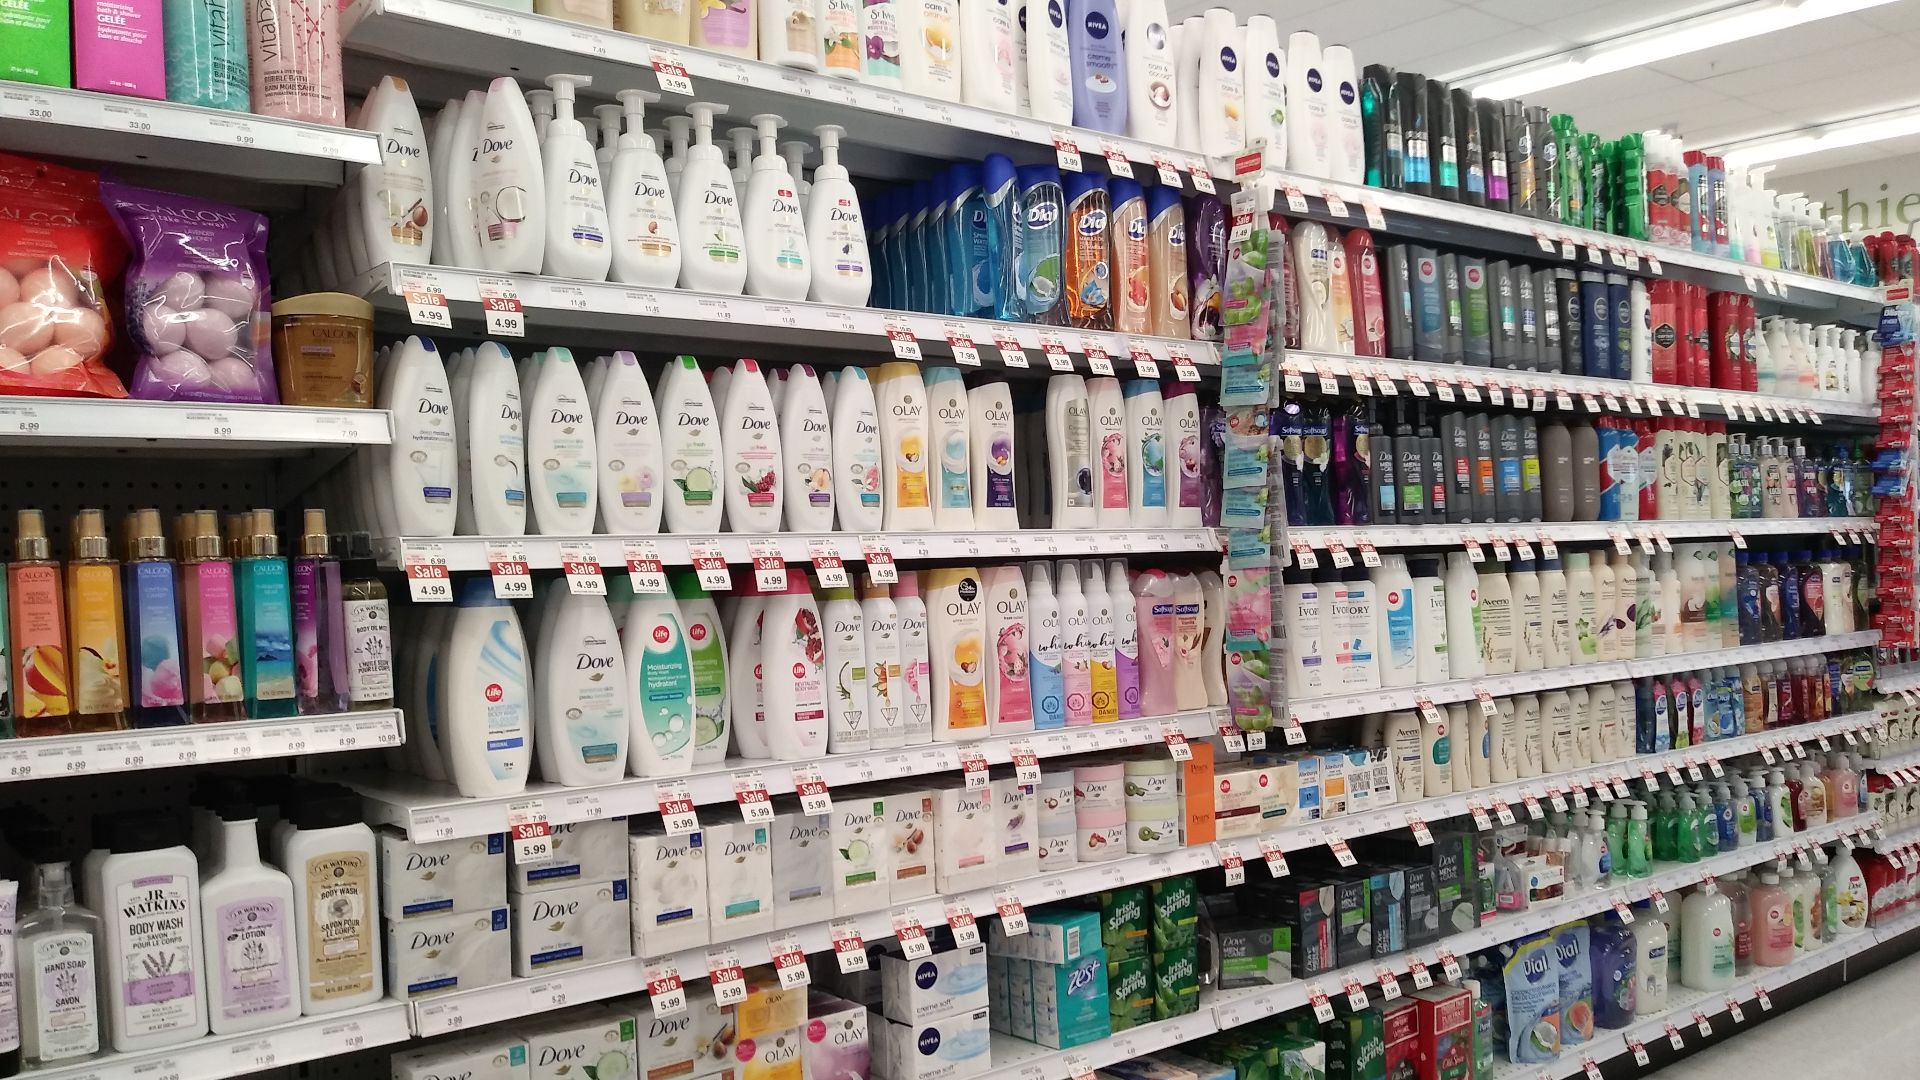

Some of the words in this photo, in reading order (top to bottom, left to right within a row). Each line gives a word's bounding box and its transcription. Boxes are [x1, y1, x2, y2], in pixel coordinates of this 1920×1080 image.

[97, 14, 126, 25] GELÉE
[1086, 23, 1107, 33] NIVEA
[592, 46, 606, 55] 7.49
[1087, 55, 1110, 64] creme
[1221, 55, 1236, 64] NIVEA
[658, 63, 683, 77] Sale
[666, 78, 688, 90] 3.99
[1308, 76, 1322, 85] NIVEA
[264, 84, 280, 93] BAIN
[29, 110, 52, 118] 33.00
[236, 135, 254, 144] 9.99
[386, 138, 421, 158] Dove
[482, 138, 513, 154] Dove
[1063, 157, 1078, 167] 3.99
[1115, 164, 1130, 175] 3.99
[569, 168, 597, 188] Dove
[773, 198, 799, 216] Dove
[137, 202, 238, 224] CALGON
[831, 207, 858, 223] Dove
[1028, 206, 1056, 225] Dial
[1234, 229, 1248, 239] 1.49
[426, 286, 442, 294] 6.99
[502, 291, 517, 300] 6.99
[489, 298, 516, 311] Sale
[418, 310, 443, 321] 4.99
[495, 318, 518, 330] 4.99
[312, 329, 356, 338] CALGON
[892, 331, 912, 342] Sale
[898, 345, 916, 355] 7.99
[959, 352, 975, 361] 7.99
[1008, 355, 1024, 363] 3.99
[1054, 359, 1070, 367] 3.99
[1288, 380, 1301, 388] 3.99
[419, 398, 449, 416] Dove
[502, 404, 521, 421] Dove
[893, 404, 921, 417] OLAY
[551, 409, 583, 424] Dove
[938, 408, 965, 420] OLAY
[985, 410, 1011, 421] OLAY
[19, 422, 40, 431] 8.99
[1100, 416, 1123, 426] OLAY
[214, 427, 232, 436] 8.99
[1303, 557, 1315, 565] 2.99
[1337, 556, 1350, 565] 2.99
[1367, 556, 1378, 564] 2.99
[18, 572, 53, 581] CALGON
[138, 566, 171, 576] CALGON
[414, 565, 441, 579] Sale
[877, 569, 894, 579] 4.99
[825, 573, 843, 583] 4.99
[420, 585, 446, 596] 4.99
[504, 582, 527, 592] 4.99
[1482, 598, 1509, 606] Aveeno
[946, 602, 980, 616] OLAY
[1176, 605, 1199, 616] Softsoap
[357, 626, 370, 634] BODY
[691, 628, 705, 637] Life
[576, 653, 614, 671] Dove
[647, 663, 682, 673] Moisturizing
[793, 666, 805, 675] Life
[648, 679, 677, 688] hydratant
[486, 688, 502, 698] Life
[377, 735, 397, 744] 10.99
[1228, 739, 1242, 748] 2.99
[233, 746, 251, 755] 8.99
[288, 741, 305, 750] 8.99
[1175, 748, 1189, 757] 2.99
[66, 761, 86, 771] 8.99
[125, 756, 144, 765] 8.99
[11, 766, 31, 776] 8.99
[1191, 763, 1209, 773] Pears
[1022, 771, 1037, 780] 7.99
[970, 777, 985, 786] 7.99
[665, 801, 689, 814] Sale
[808, 800, 826, 811] 5.99
[586, 807, 602, 816] 11.99
[750, 807, 770, 818] 5.99
[1192, 812, 1209, 823] Pears
[672, 818, 694, 829] 5.99
[436, 828, 454, 837] 11.99
[523, 843, 546, 856] 5.99
[1230, 872, 1242, 880] 3.99
[146, 889, 163, 903] JR
[321, 891, 338, 900] BODY
[340, 888, 358, 897] WASH
[1166, 888, 1185, 905] Irish
[123, 898, 187, 919] WATKINS
[1114, 900, 1135, 916] Irish
[1159, 893, 1191, 918] Spring
[1109, 906, 1141, 930] Spring
[129, 920, 154, 935] BODY
[157, 917, 183, 932] WASH
[241, 930, 266, 939] LOTION
[900, 927, 921, 939] Sale
[133, 941, 151, 949] POUR
[163, 936, 182, 945] CORPS
[839, 938, 859, 951] Sale
[1556, 944, 1579, 963] Dial
[45, 962, 65, 973] HAND
[66, 960, 87, 970] SOAP
[1168, 958, 1188, 974] Irish
[1524, 958, 1548, 975] Dial
[664, 968, 677, 977] 7.29
[917, 971, 937, 980] NIVEA
[1120, 970, 1142, 985] Irish
[1162, 962, 1193, 988] Spring
[56, 996, 80, 1007] SAVON
[660, 997, 680, 1009] 5.99
[916, 1005, 940, 1014] creme
[941, 999, 952, 1007] soft
[447, 1015, 463, 1026] 3.99
[345, 1036, 363, 1046] 10.99
[920, 1037, 938, 1046] NIVEA
[1360, 1036, 1379, 1054] Irish
[255, 1054, 275, 1065] 11.99
[1356, 1040, 1385, 1072] Spring
[919, 1071, 942, 1080] creme
[943, 1066, 955, 1074] soft
